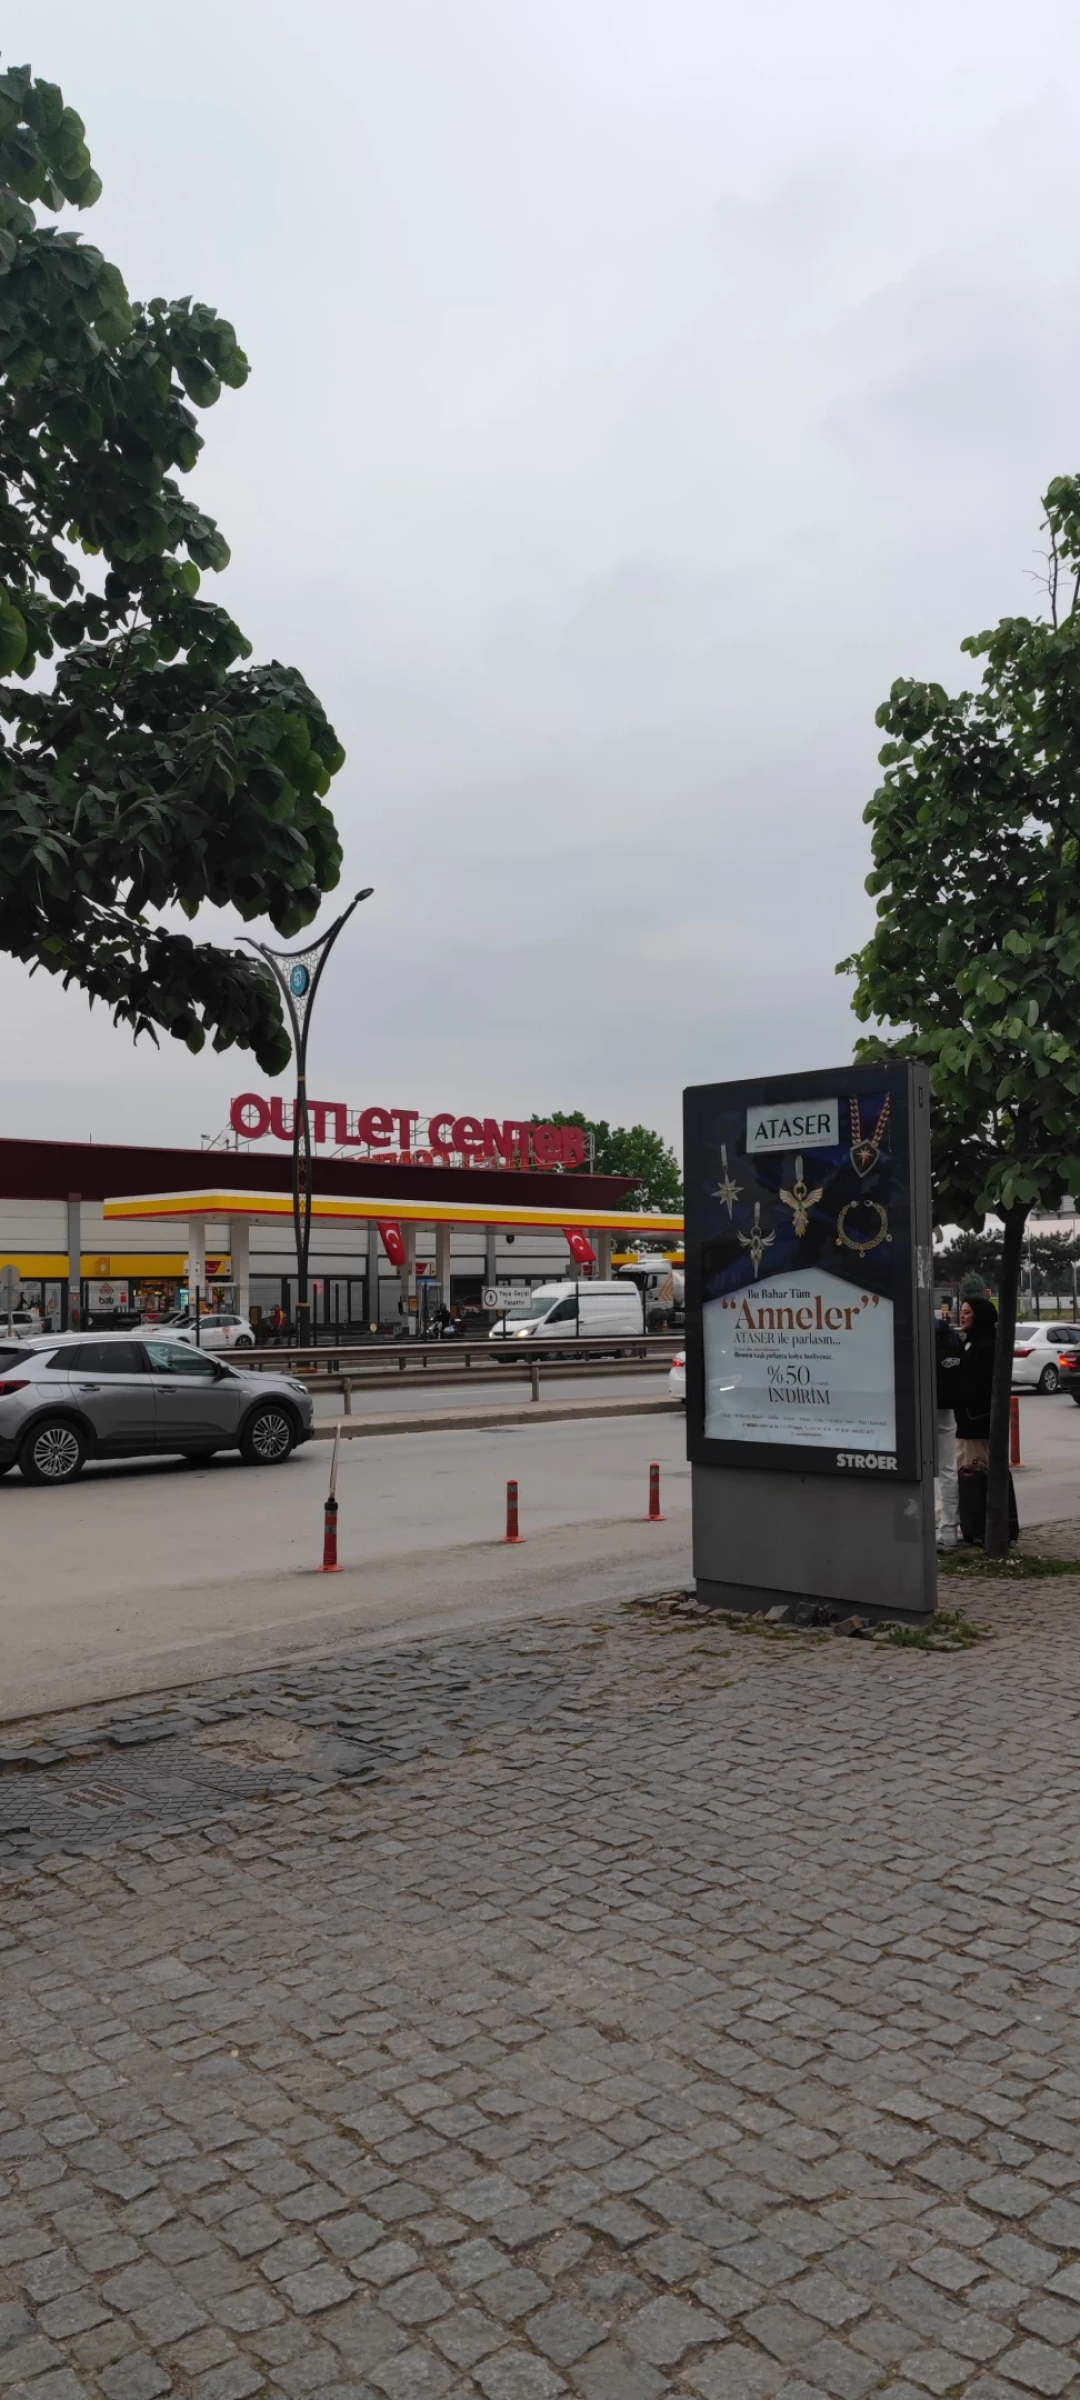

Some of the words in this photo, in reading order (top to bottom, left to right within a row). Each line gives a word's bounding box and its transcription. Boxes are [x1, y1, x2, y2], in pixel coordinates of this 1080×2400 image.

[754, 1113, 831, 1140] ATASER
[748, 1289, 760, 1299] Bu
[761, 1290, 788, 1299] Bahar
[789, 1288, 811, 1299] Tüm
[733, 1332, 775, 1344] ATASER
[777, 1333, 790, 1344] ile
[767, 1365, 811, 1386] %50
[768, 1386, 831, 1405] İNDİRİM
[836, 1453, 898, 1470] STRÖER
